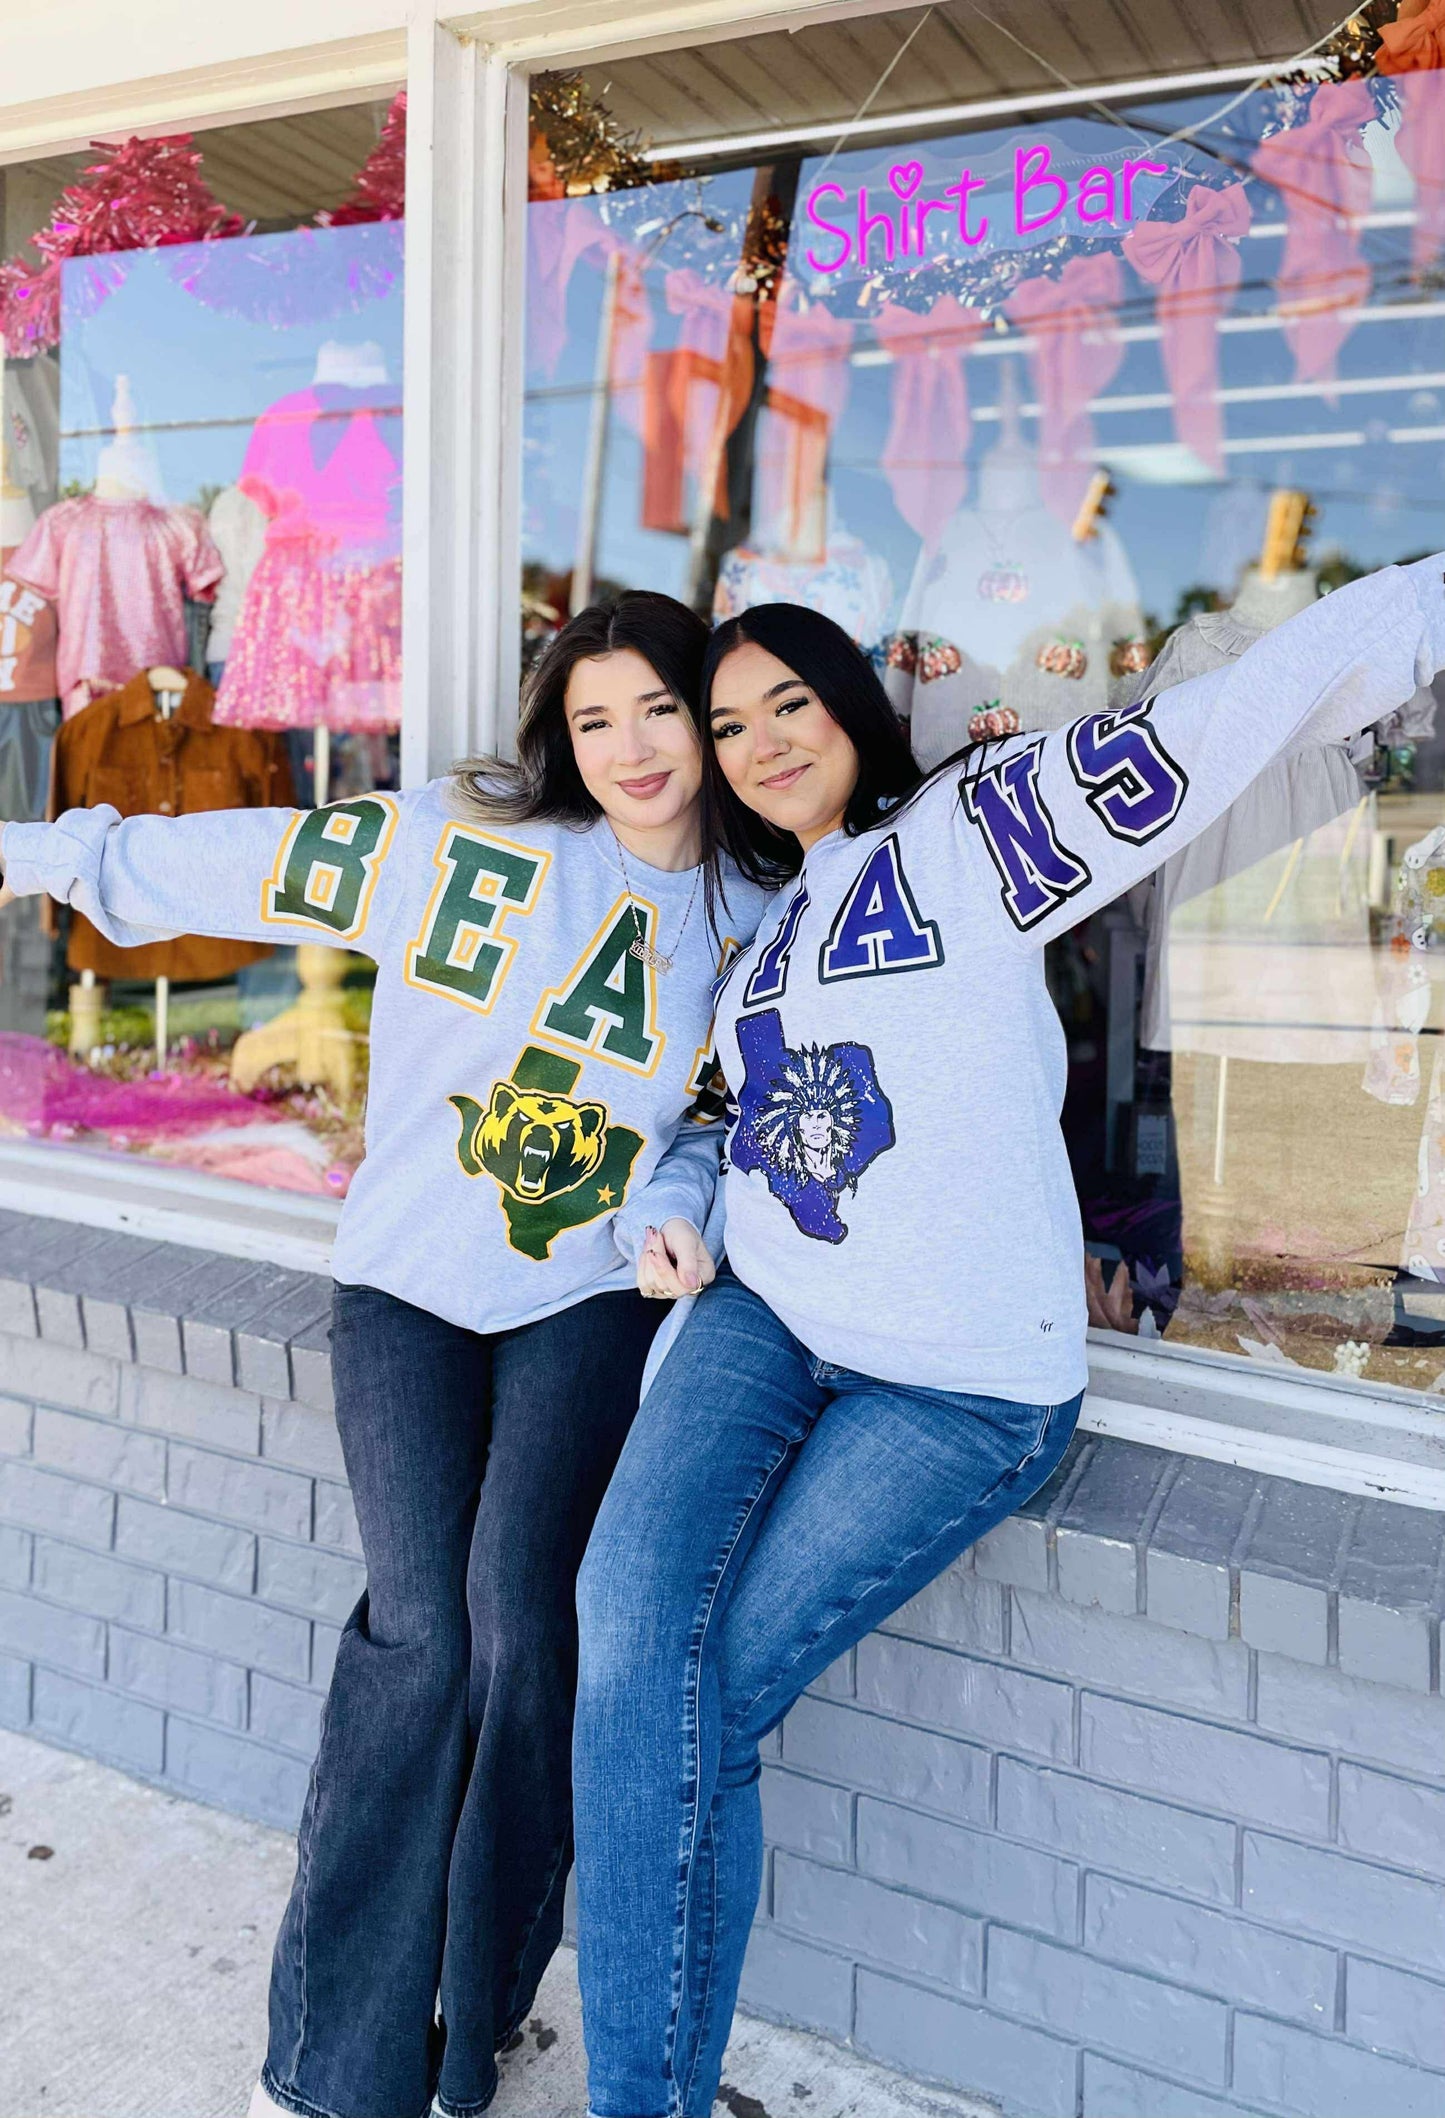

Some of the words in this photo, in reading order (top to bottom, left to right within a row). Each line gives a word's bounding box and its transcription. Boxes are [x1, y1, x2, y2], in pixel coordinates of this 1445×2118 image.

[807, 160, 988, 274] Shirt
[1014, 144, 1169, 236] Bar
[711, 697, 1189, 1009] IANS
